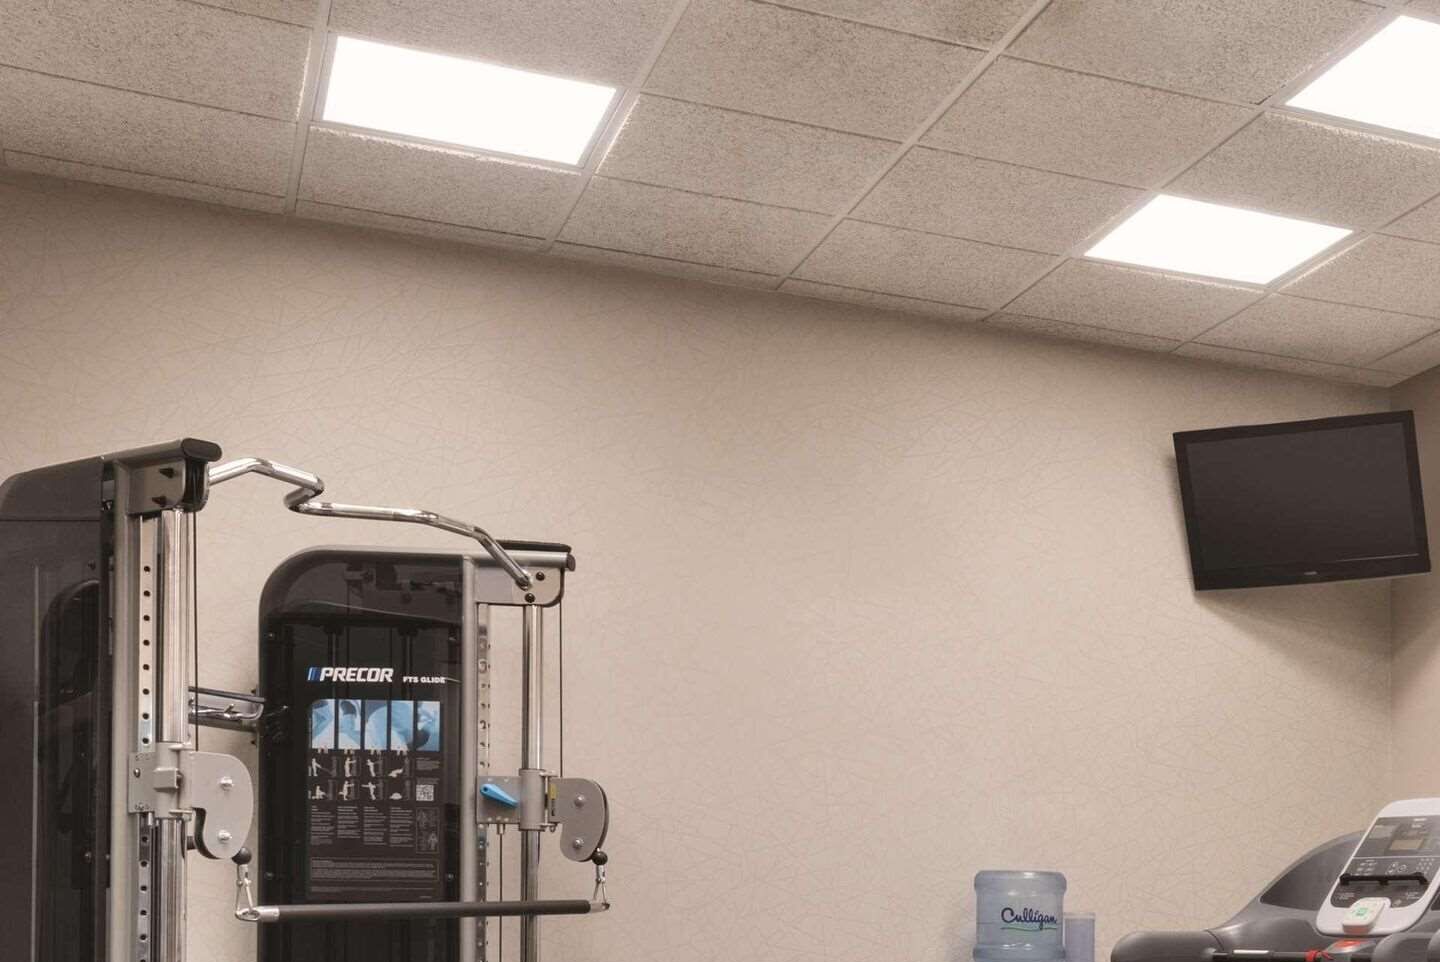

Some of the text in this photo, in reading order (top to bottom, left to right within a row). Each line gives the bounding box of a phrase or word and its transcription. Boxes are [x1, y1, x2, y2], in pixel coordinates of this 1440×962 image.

[319, 666, 394, 683] PRECOR
[420, 676, 446, 684] GLIDE
[1000, 907, 1057, 931] Culligan
